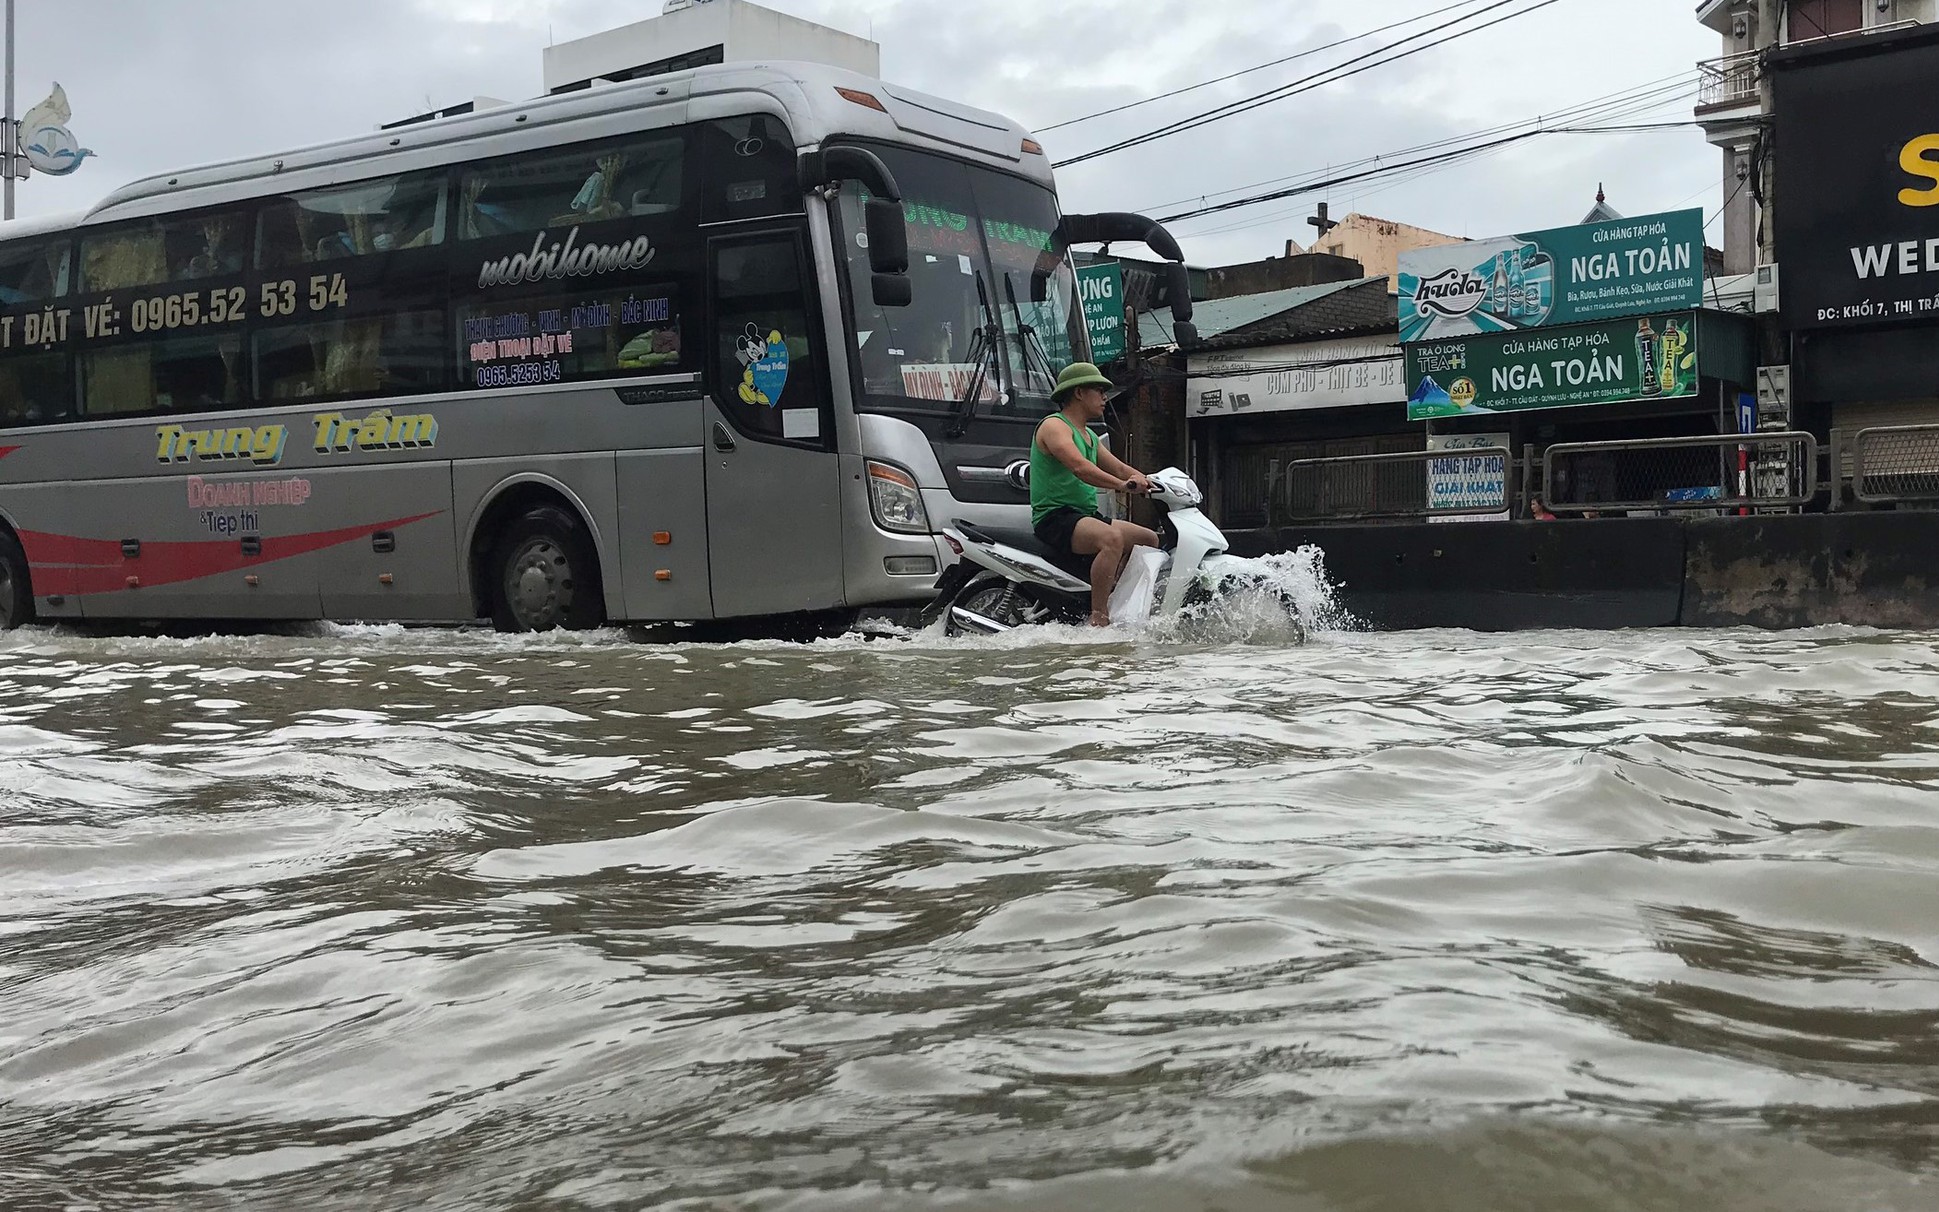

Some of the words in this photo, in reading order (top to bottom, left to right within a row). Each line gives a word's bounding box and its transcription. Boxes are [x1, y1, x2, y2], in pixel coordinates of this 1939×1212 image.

[1593, 228, 1609, 242] CỬA
[1610, 226, 1632, 240] HÀNG
[1633, 224, 1648, 239] TẠP
[1649, 221, 1667, 234] HÓA
[478, 225, 656, 289] mobihome
[1571, 252, 1620, 283] NGA
[1625, 237, 1691, 276] TOẢN
[1599, 286, 1616, 298] Bánh
[1678, 277, 1694, 288] Khát
[24, 307, 71, 350] ĐẶT
[84, 296, 120, 339] VÉ:
[131, 286, 247, 333] 0965.52
[260, 280, 297, 317] 53
[309, 273, 347, 311] 54
[643, 297, 669, 323] NINH
[1092, 303, 1103, 313] AN
[1817, 308, 1840, 321] ĐC:
[1843, 299, 1874, 318] KHỐI
[1877, 302, 1889, 316] 7,
[1894, 300, 1913, 314] THỊ
[470, 338, 497, 364] ĐIỆN
[498, 336, 531, 360] THOẠI
[532, 329, 555, 359] ĐẶT
[557, 331, 573, 353] VÉ
[1443, 343, 1466, 353] LONG
[1502, 340, 1525, 355] CỬA
[1527, 337, 1558, 353] HÀNG
[1561, 335, 1582, 350] TẠP
[1585, 331, 1610, 346] HÓA
[1492, 363, 1544, 392] NGA
[1551, 348, 1623, 387] TOẢN
[1452, 381, 1465, 394] SỐ
[1465, 382, 1471, 394] 1
[156, 424, 289, 467] Trung
